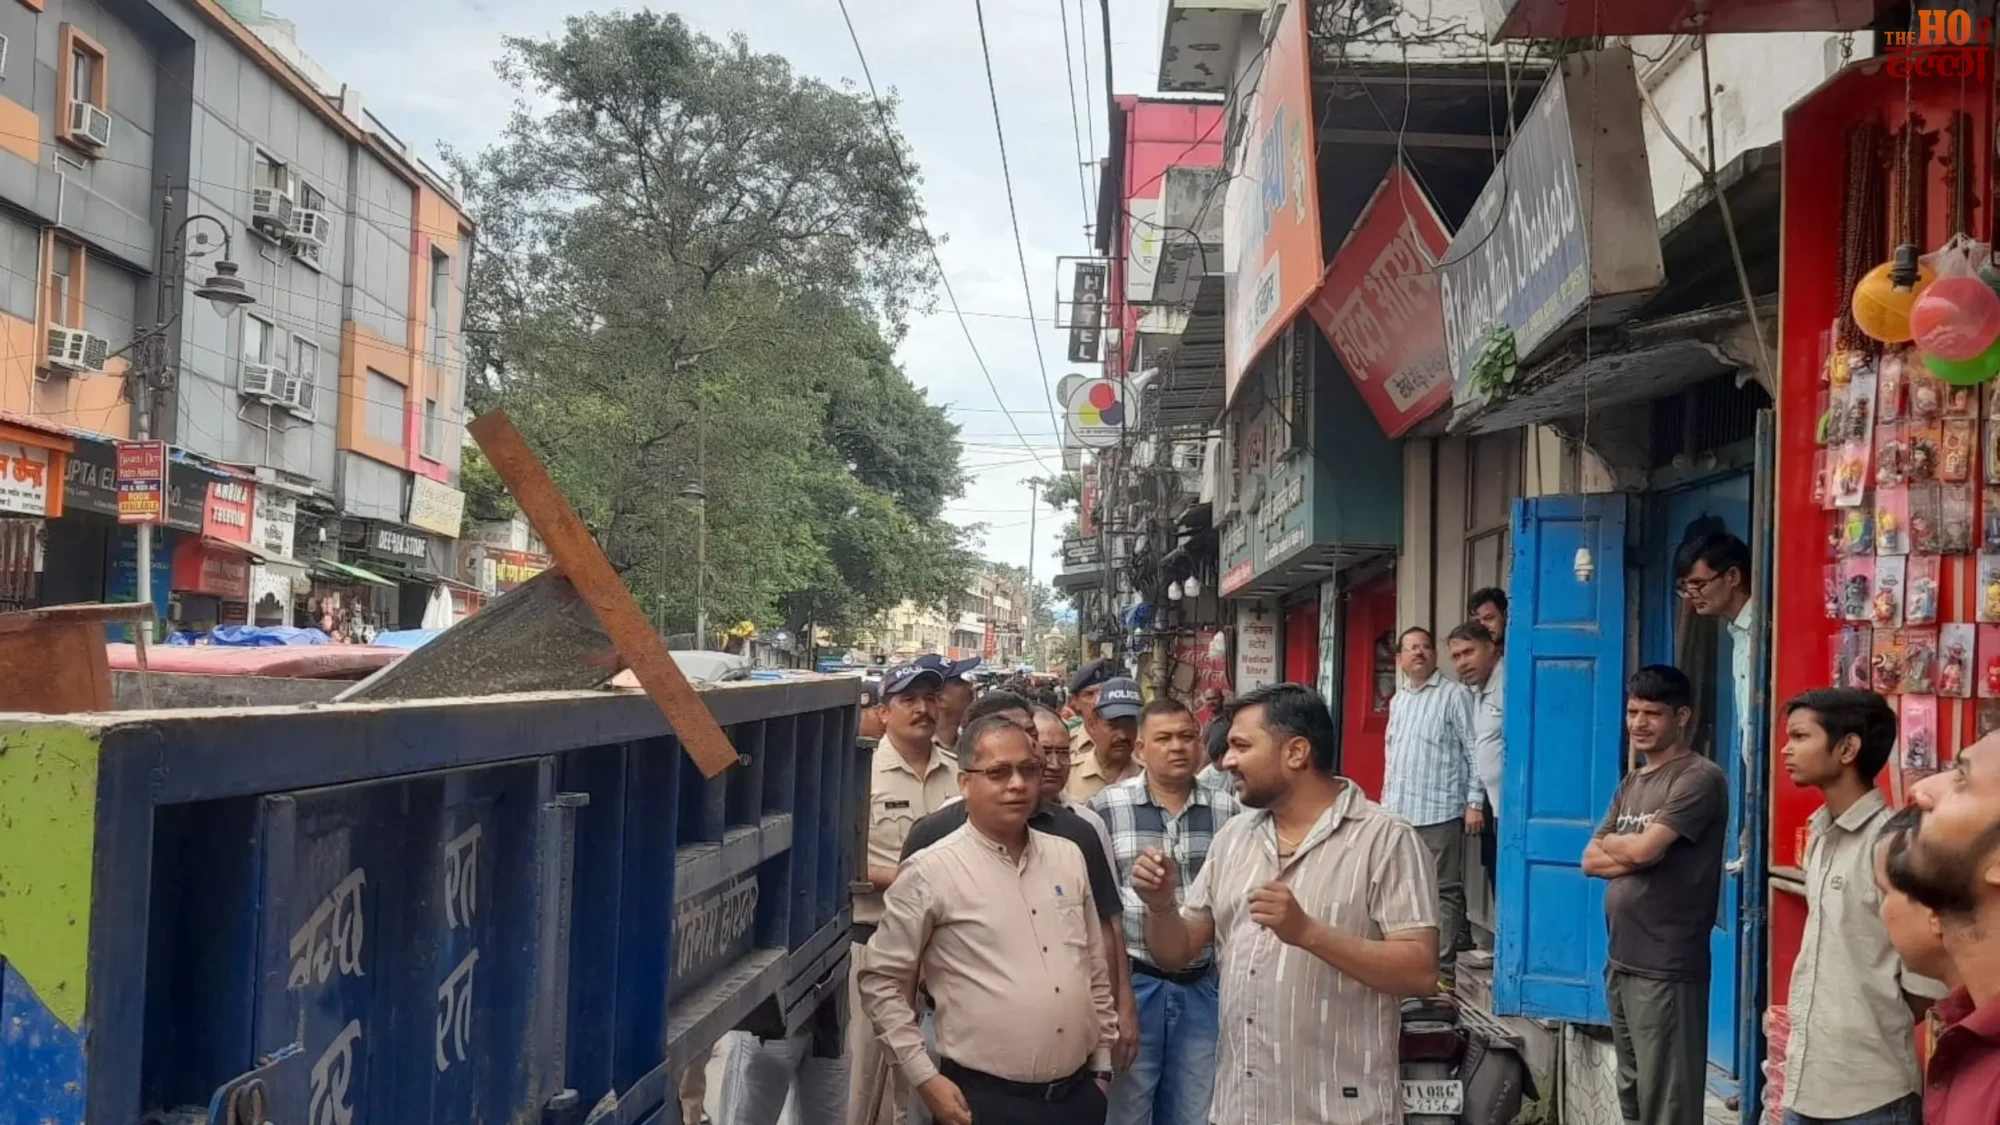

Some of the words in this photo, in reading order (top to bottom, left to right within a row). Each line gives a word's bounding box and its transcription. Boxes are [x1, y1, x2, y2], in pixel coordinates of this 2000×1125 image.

[1078, 274, 1100, 360] HOTEL
[1321, 285, 1389, 381] होटल
[65, 459, 96, 487] UPTA
[406, 534, 426, 558] STORE
[1241, 654, 1274, 664] Medical
[896, 666, 923, 679] POLI
[1245, 666, 1268, 676] Store
[1108, 689, 1141, 701] POLICE
